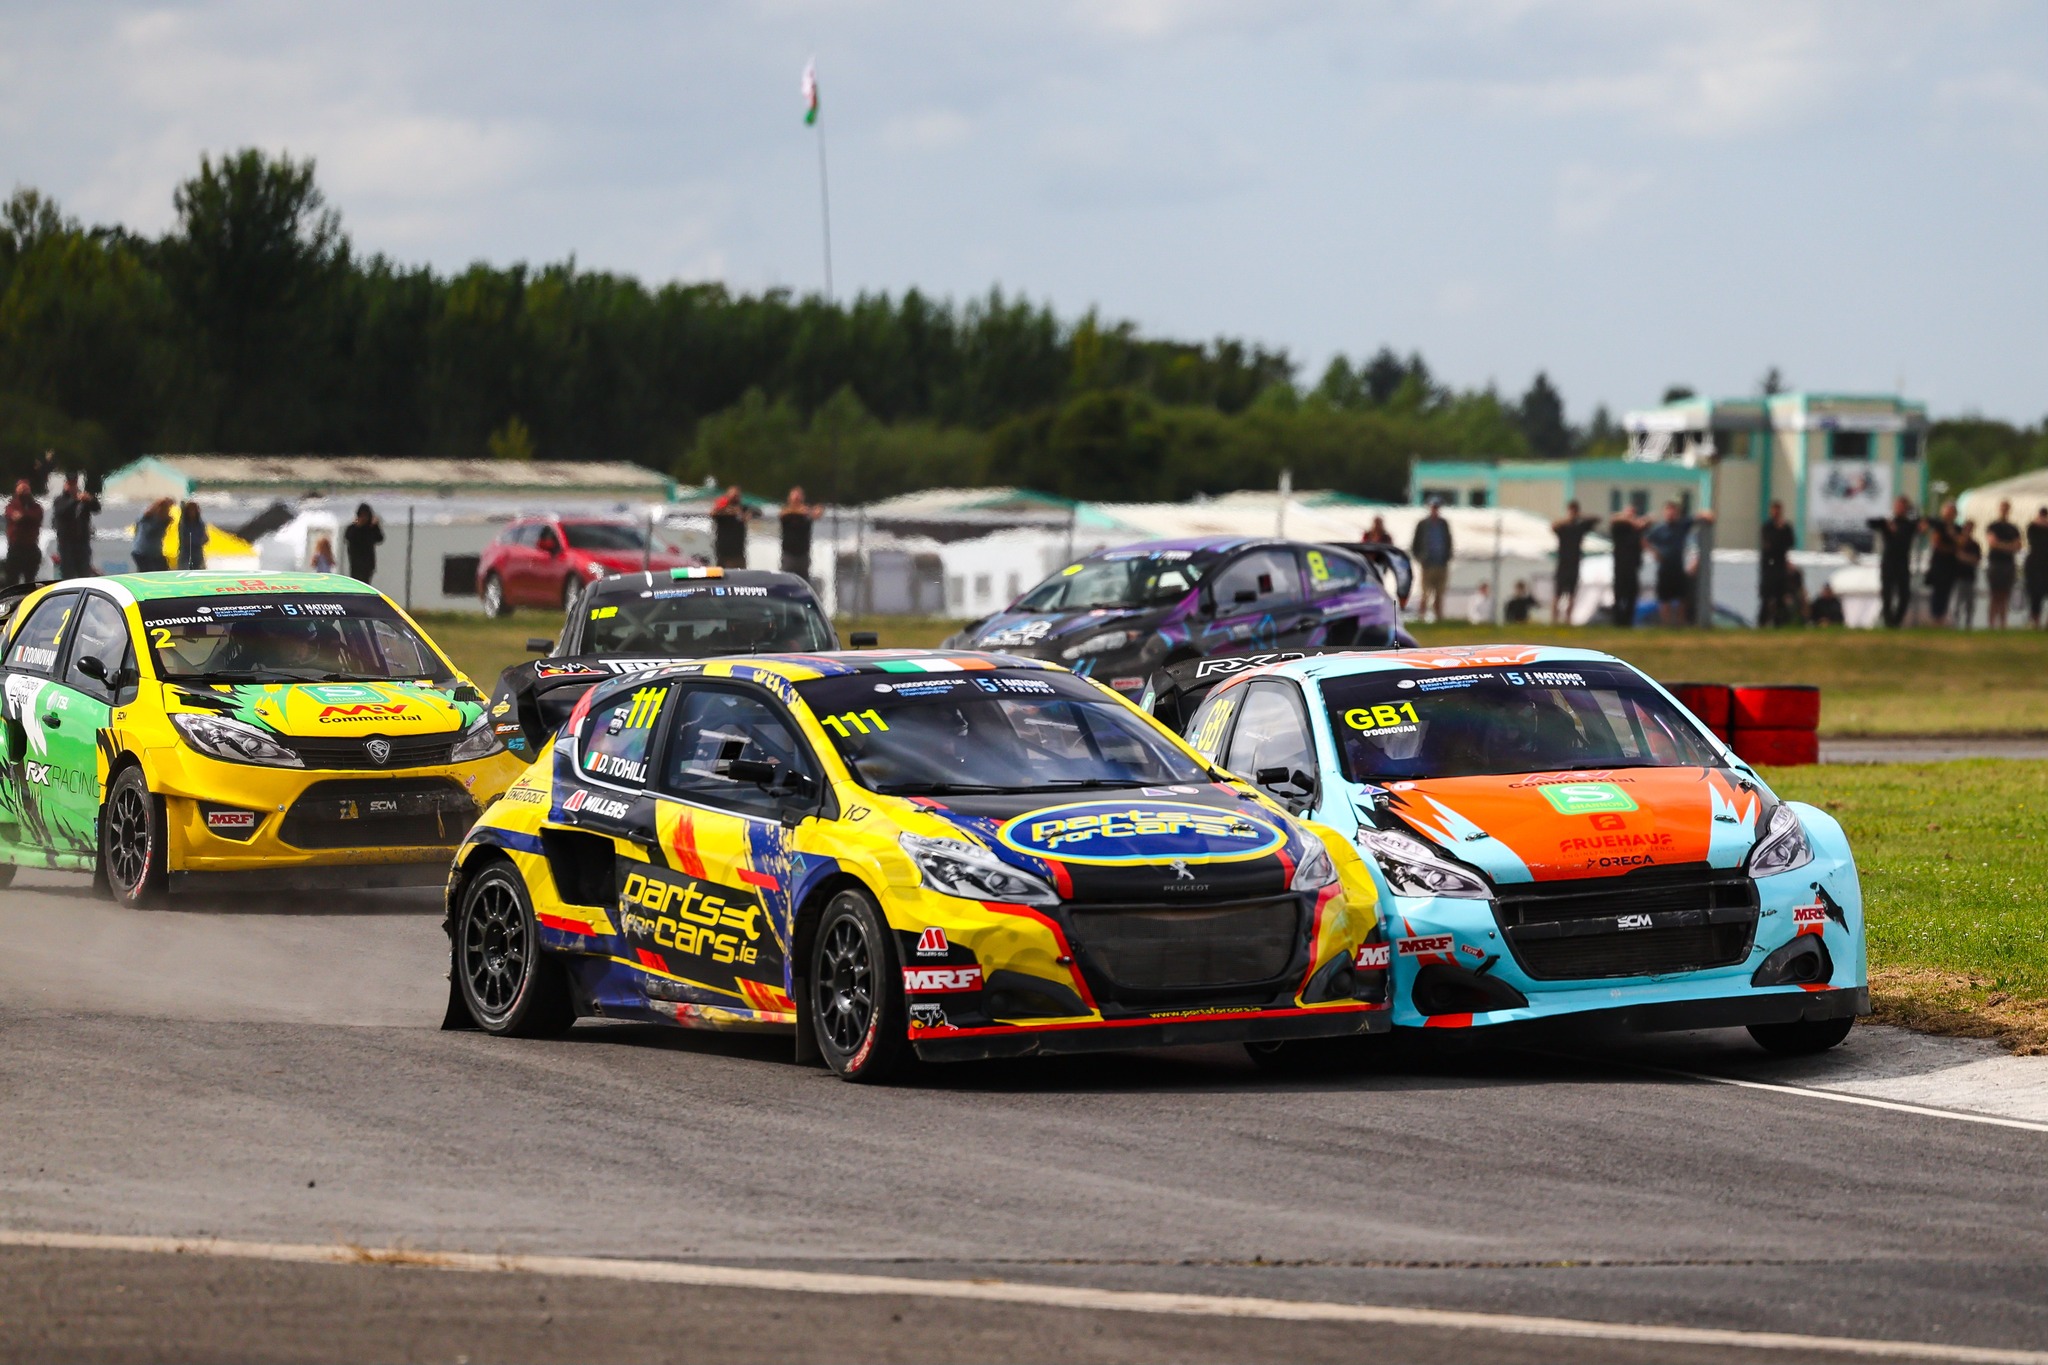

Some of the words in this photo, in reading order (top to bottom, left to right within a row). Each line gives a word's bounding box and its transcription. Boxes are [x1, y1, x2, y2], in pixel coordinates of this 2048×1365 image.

[283, 604, 298, 615] 5
[53, 609, 71, 645] 2
[145, 616, 213, 627] O'DONOVAN
[150, 628, 176, 649] 2
[23, 646, 57, 667] O'DONOVAN
[1196, 653, 1279, 678] RX
[1002, 679, 1049, 688] NATIONS
[1416, 674, 1479, 685] motorsport
[1507, 672, 1525, 686] 5
[1534, 672, 1582, 681] NATIONS
[1539, 679, 1587, 687] TROPHY
[892, 680, 950, 690] motorsport
[976, 678, 998, 692] 5
[1010, 686, 1056, 694] TROPHY
[1421, 684, 1470, 692] Championship
[55, 695, 70, 710] TSL
[625, 687, 668, 729] 111
[319, 715, 421, 724] Commercial
[821, 709, 889, 737] 111
[1344, 702, 1420, 731] GB1
[1198, 698, 1236, 753] GB1
[1363, 725, 1417, 737] O'DONOVAN
[597, 755, 607, 772] D.
[610, 757, 646, 783] TOHILL
[26, 760, 51, 787] RX
[51, 765, 106, 798] RACING
[370, 801, 397, 811] SCM
[582, 796, 630, 819] MILLERS
[209, 814, 253, 825] MRF
[1032, 810, 1191, 842] parts
[1559, 833, 1673, 852] FRUEHAUF
[1599, 855, 1654, 867] ORECA
[1163, 884, 1210, 892] PEUGEOT
[619, 873, 726, 933] parts
[1617, 914, 1653, 928] SCM
[1794, 908, 1826, 922] MRF
[1399, 937, 1453, 954] MRF
[903, 968, 981, 990] MRF
